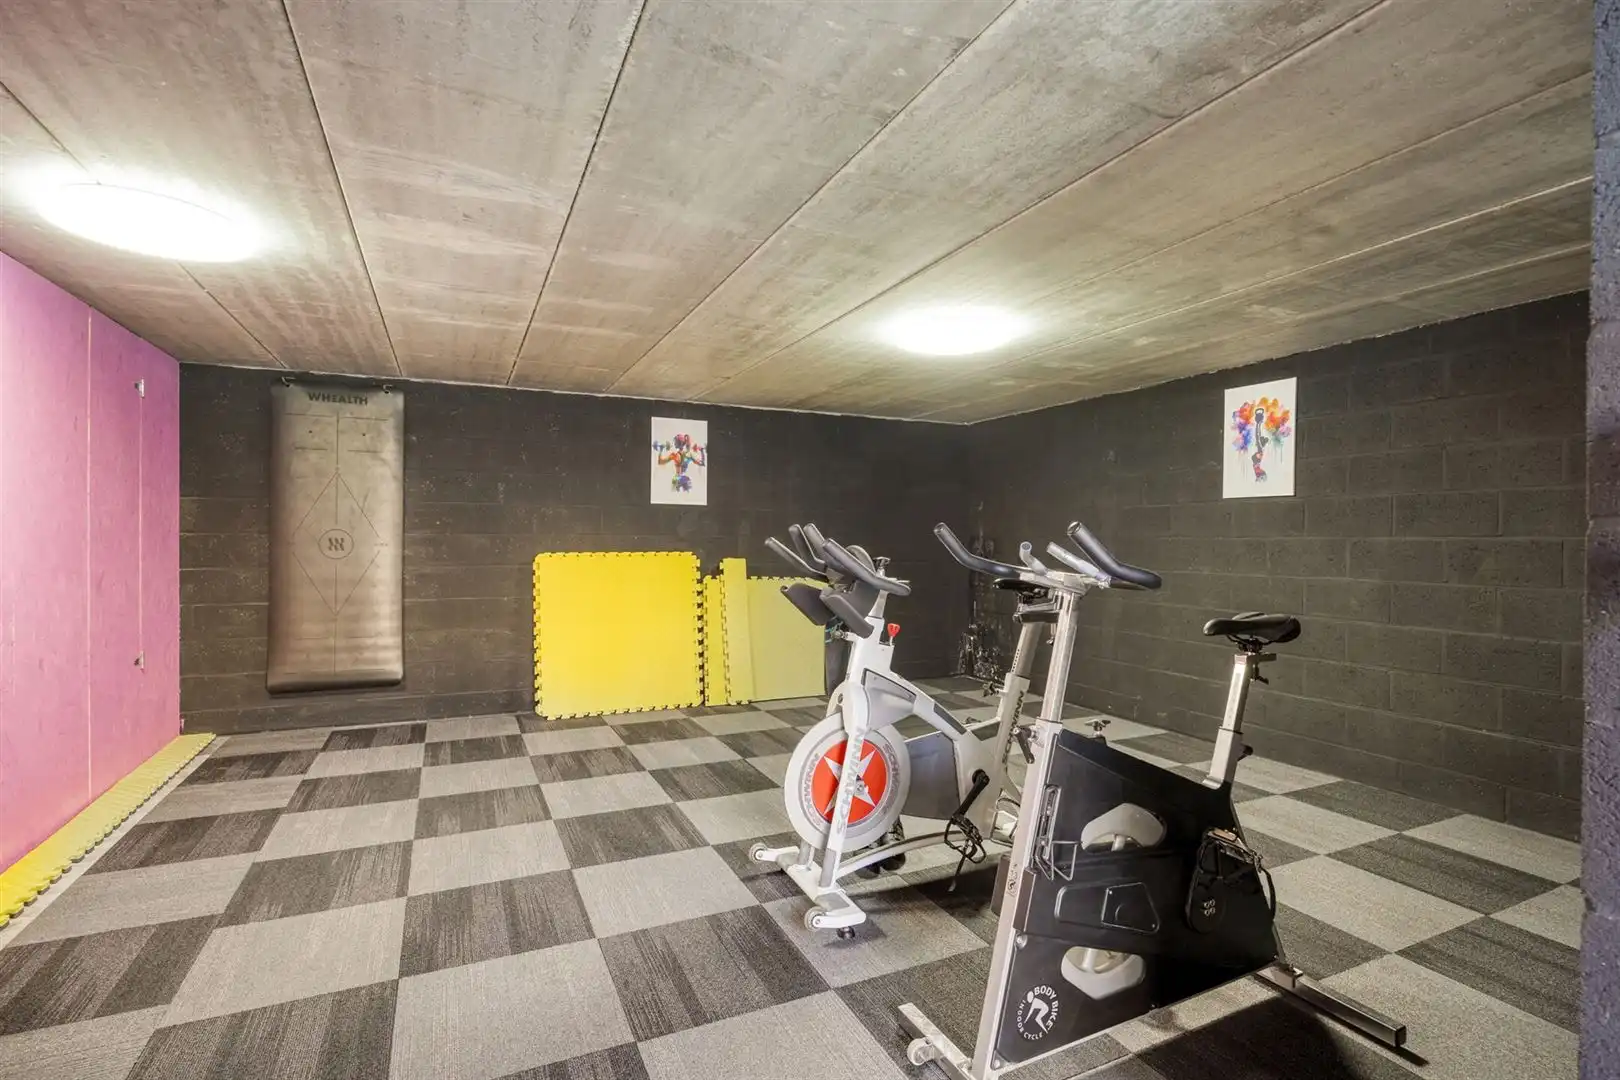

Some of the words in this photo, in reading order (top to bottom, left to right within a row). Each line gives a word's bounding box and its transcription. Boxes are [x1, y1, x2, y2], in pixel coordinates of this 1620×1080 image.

[308, 392, 368, 405] WHEALTH
[1017, 1000, 1026, 1033] INDOOR
[1023, 1031, 1043, 1040] CYCLE
[1034, 985, 1057, 1000] BODY
[1046, 1000, 1059, 1031] BIKE
